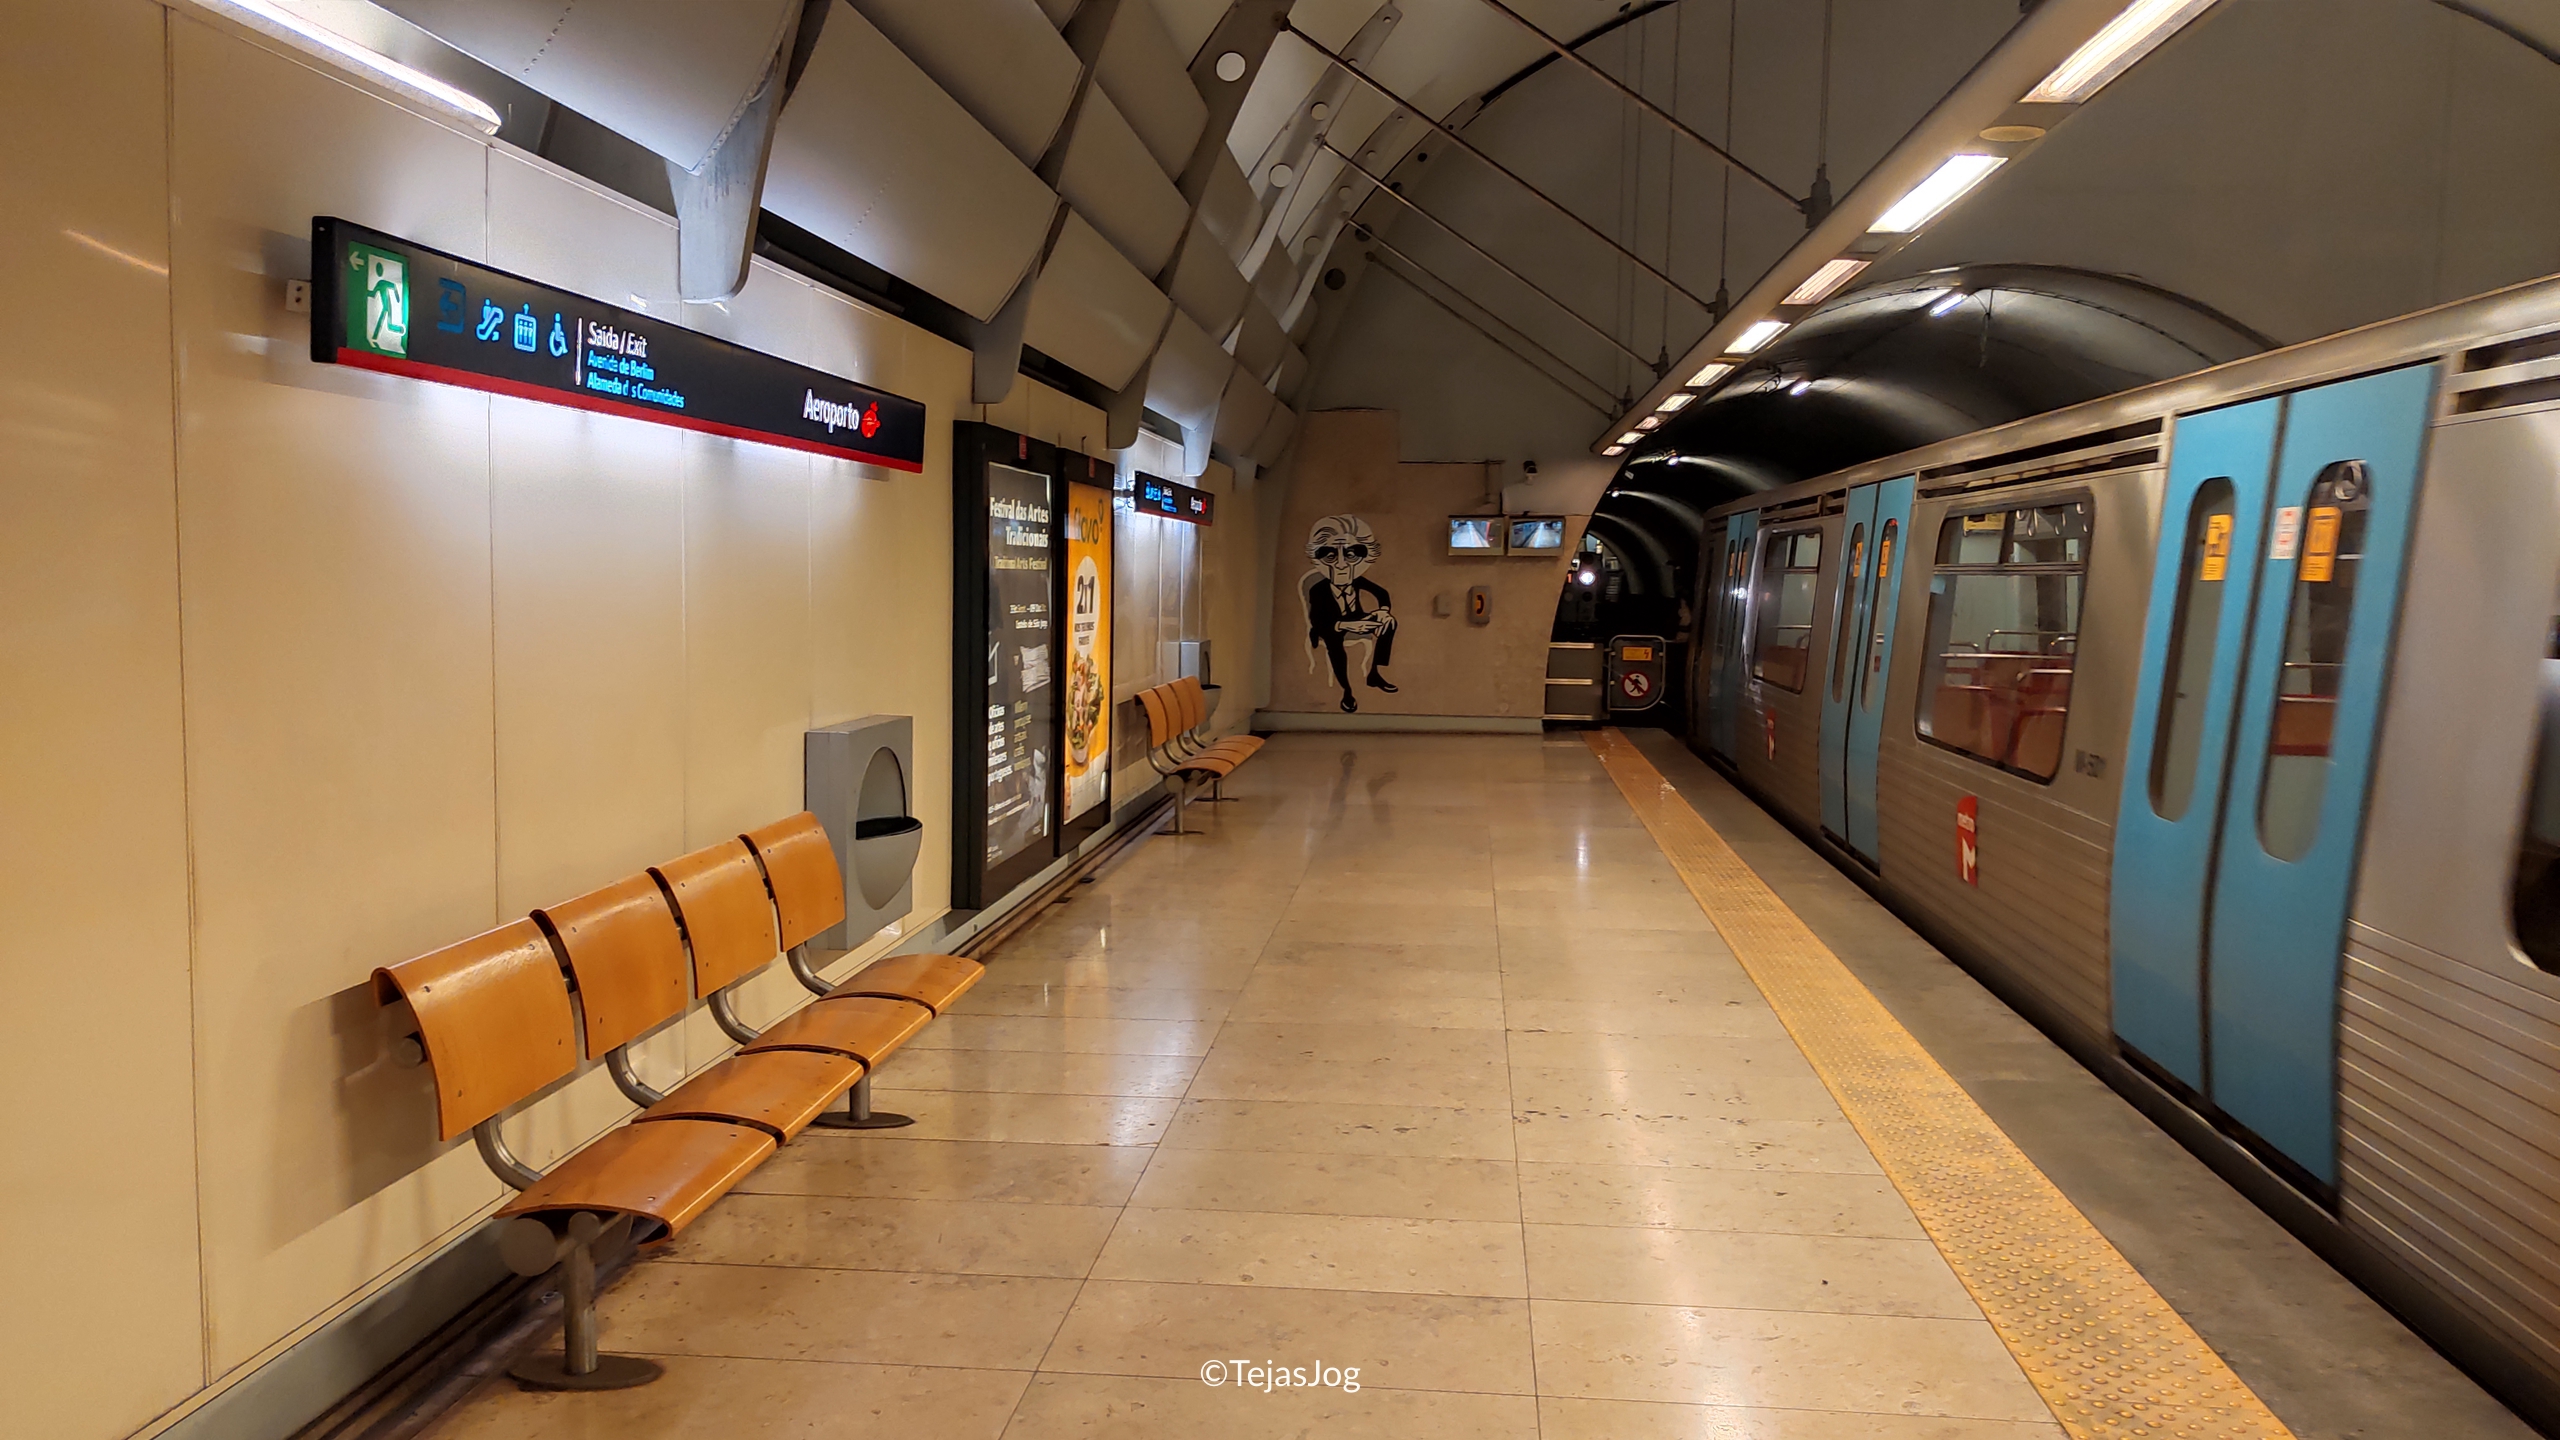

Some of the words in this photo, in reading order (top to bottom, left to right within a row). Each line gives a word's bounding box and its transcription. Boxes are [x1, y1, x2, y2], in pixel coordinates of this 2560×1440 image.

[587, 321, 619, 350] Saída
[626, 332, 647, 358] Exit
[619, 357, 630, 375] de
[586, 371, 622, 395] Alameda
[622, 379, 637, 398] ds
[803, 388, 860, 434] Aeroporto
[989, 496, 1015, 520] Festival
[1027, 503, 1049, 524] Artes
